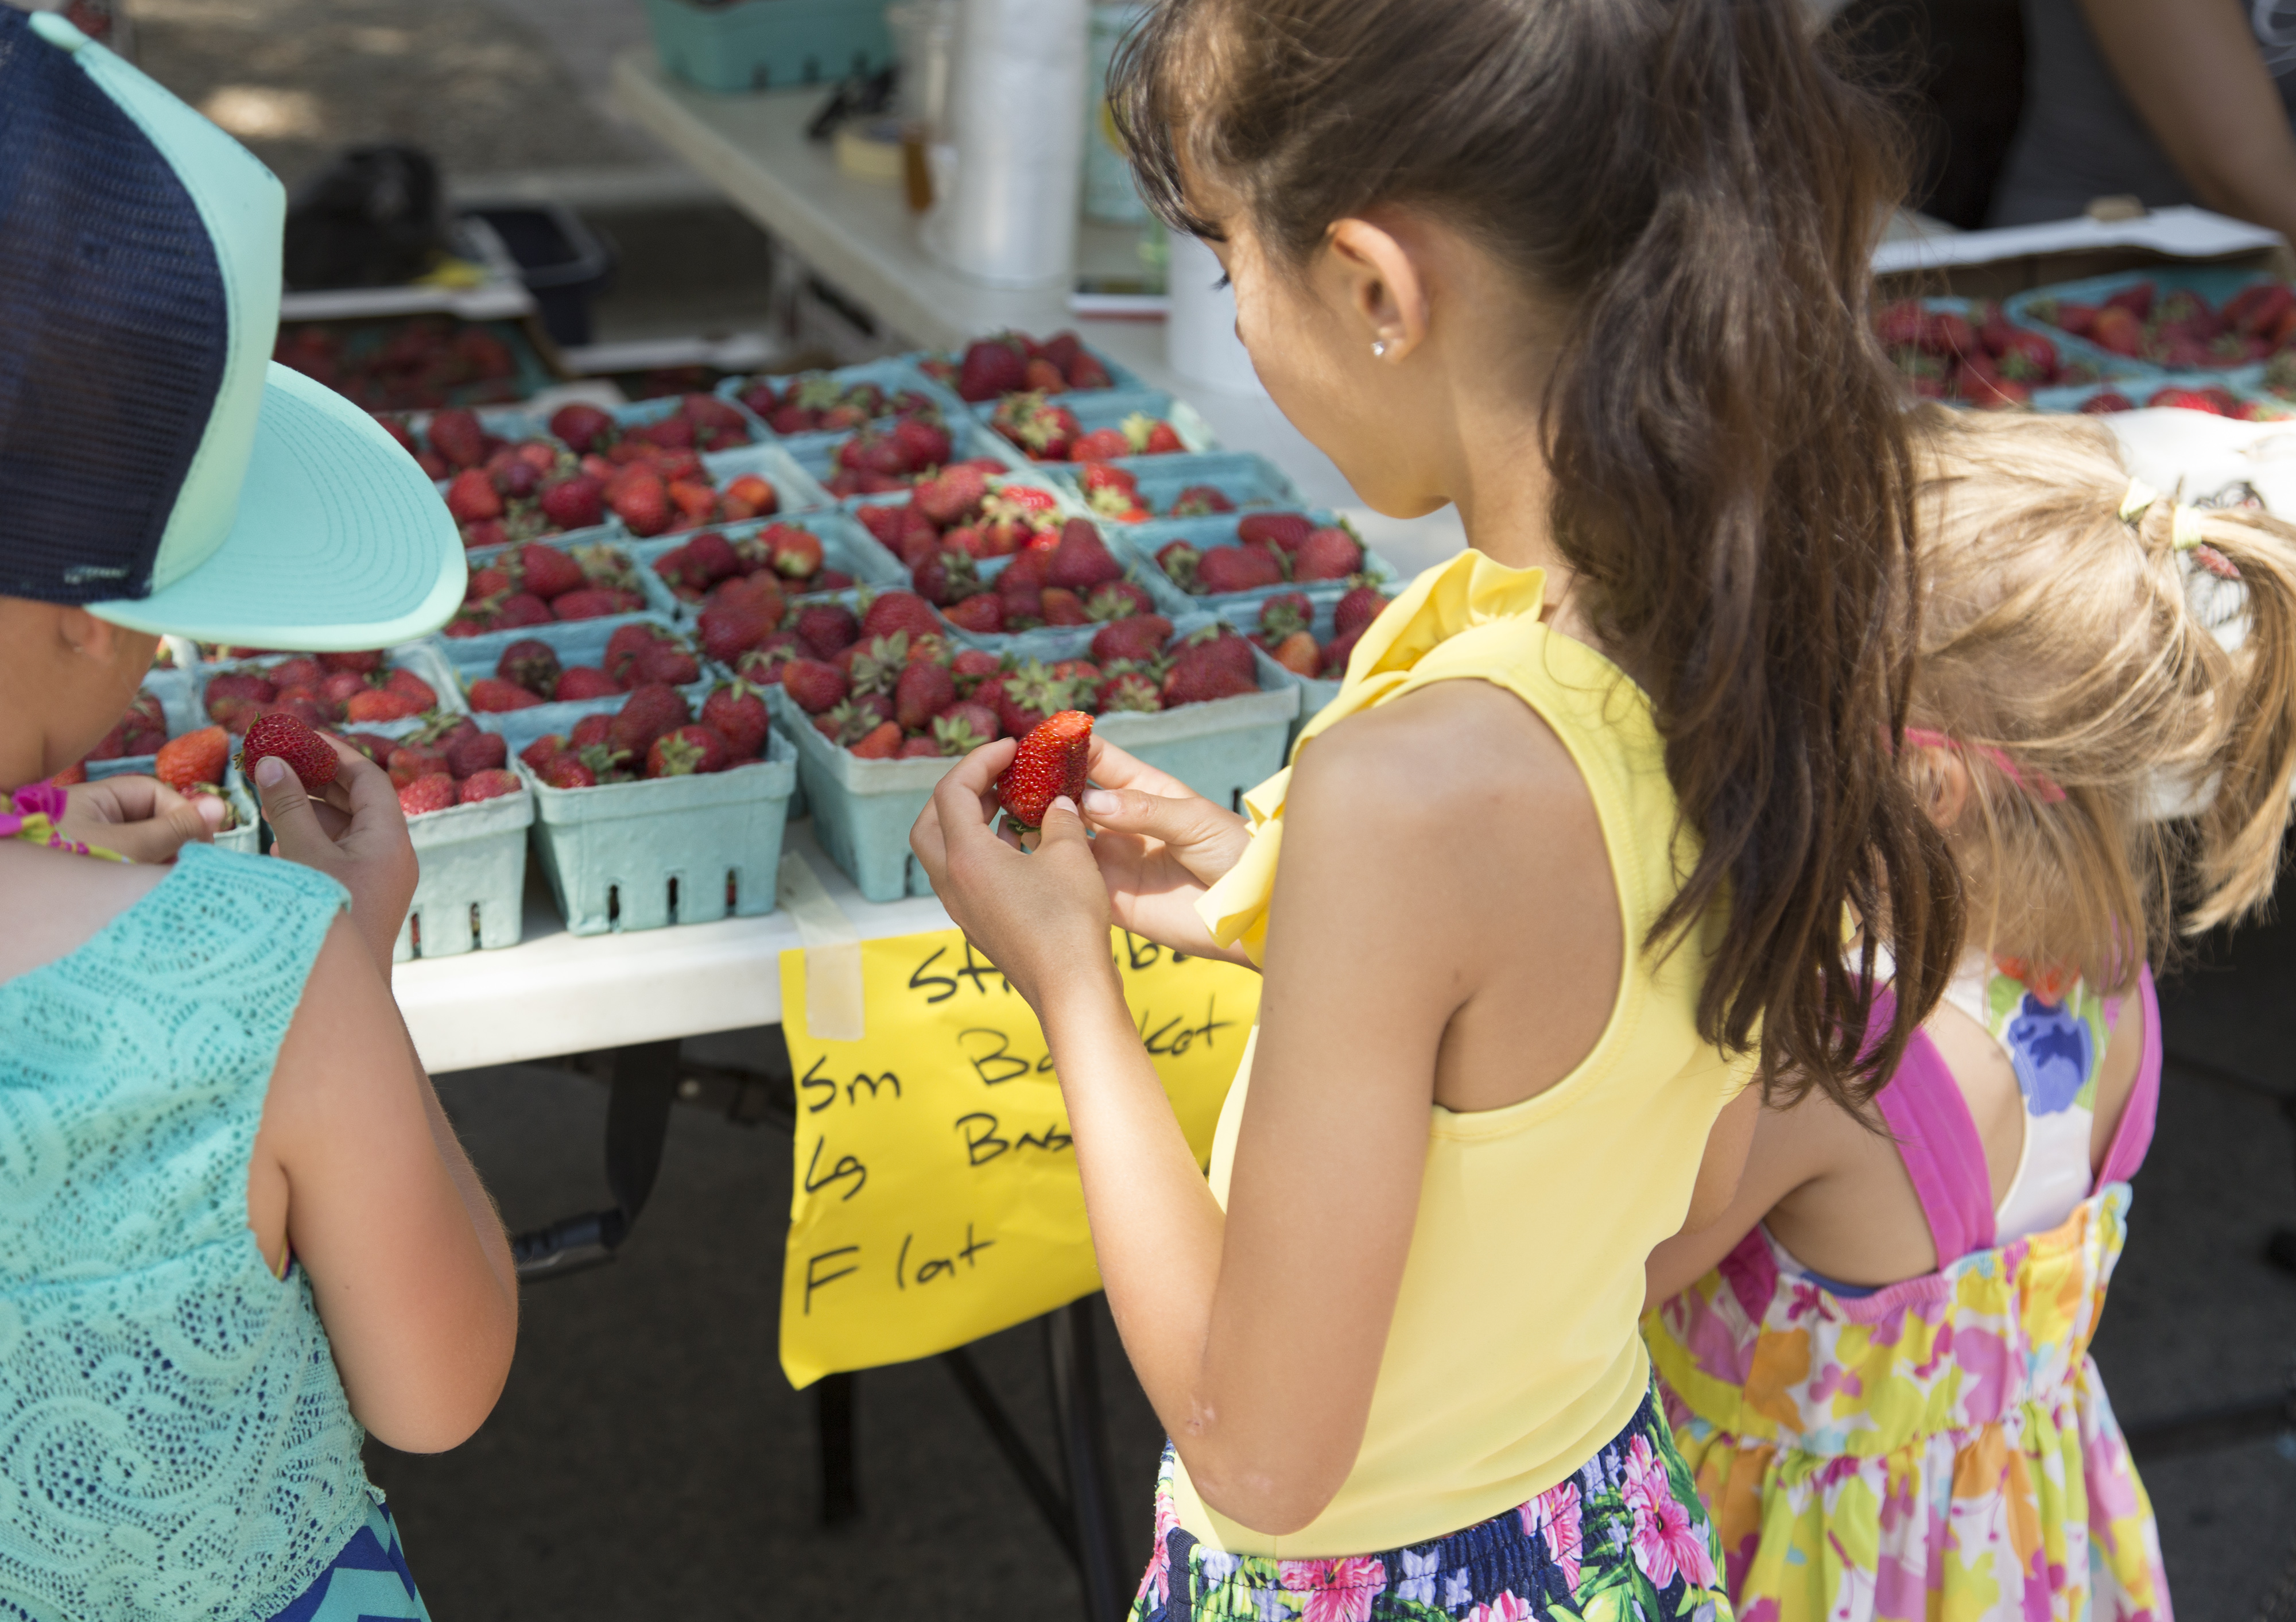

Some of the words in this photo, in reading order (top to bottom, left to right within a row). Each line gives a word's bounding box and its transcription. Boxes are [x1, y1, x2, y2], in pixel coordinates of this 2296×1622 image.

[800, 1054, 902, 1114] Sm
[957, 992, 1236, 1086] Baket
[804, 1135, 867, 1202] Lg
